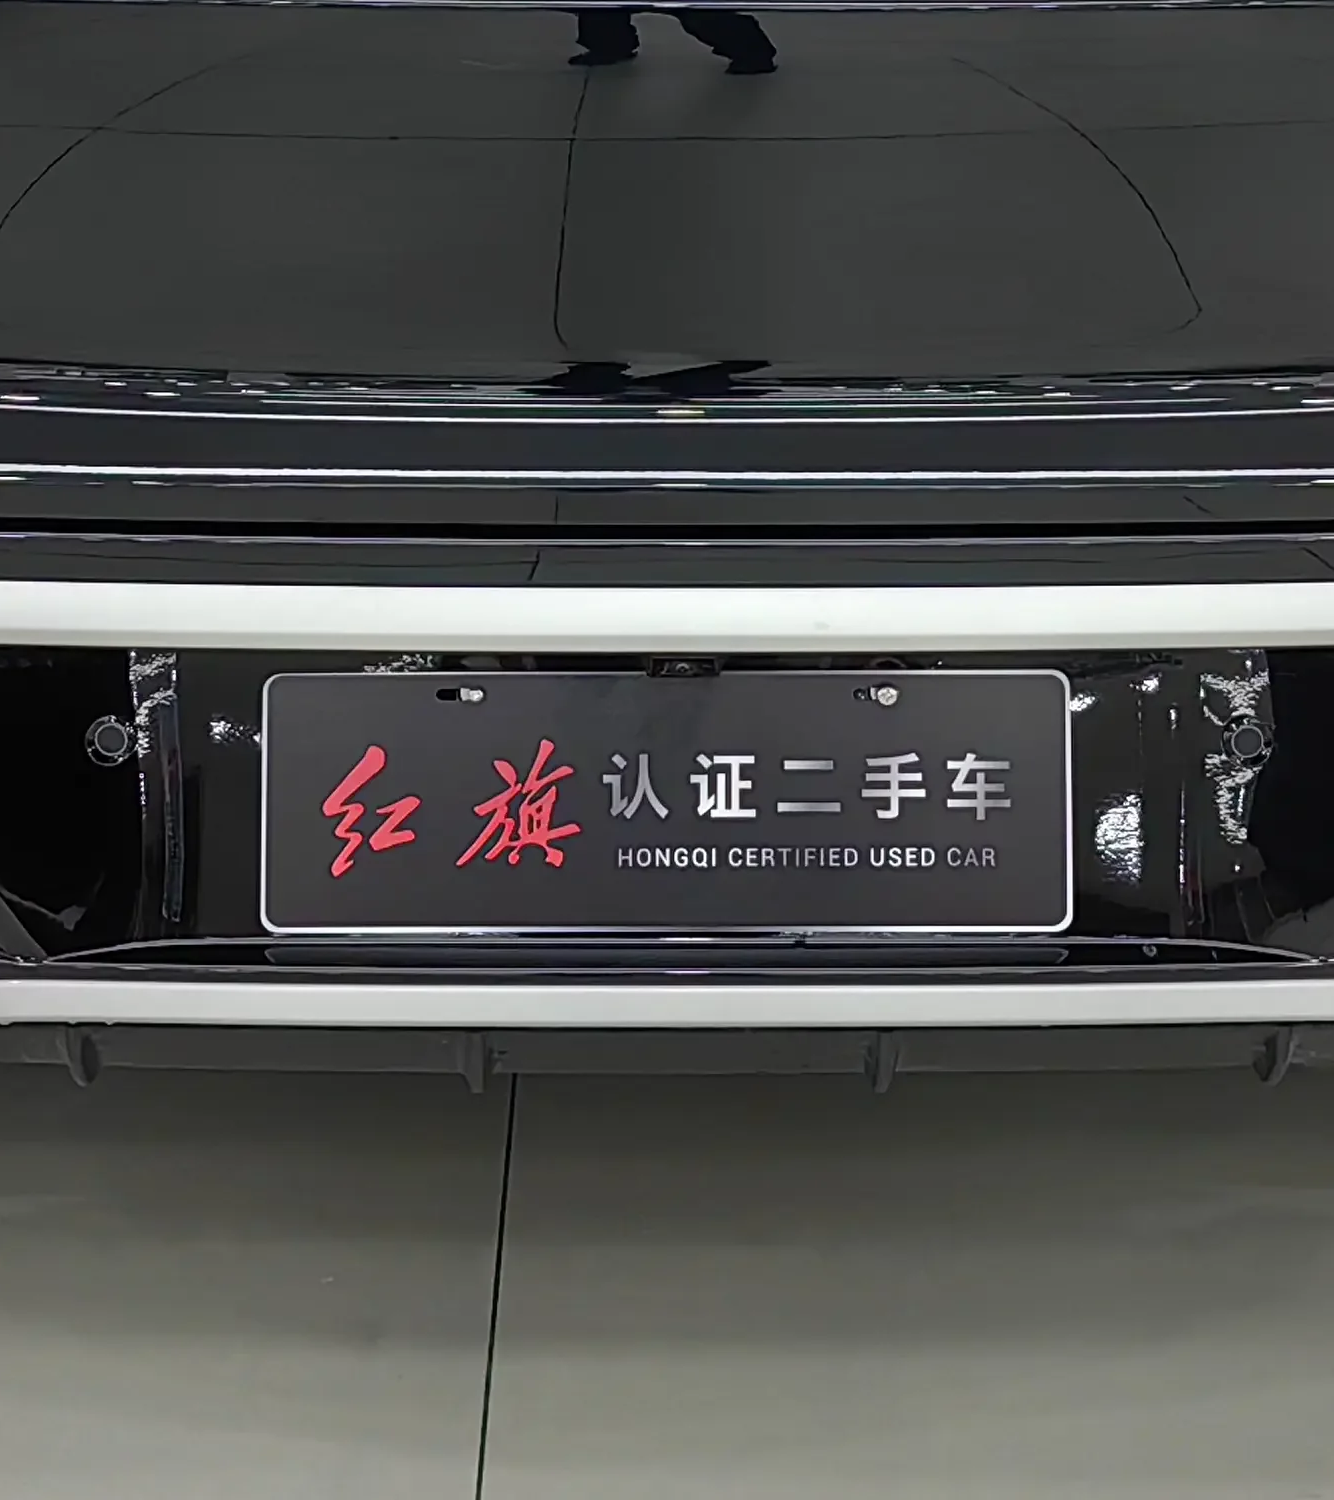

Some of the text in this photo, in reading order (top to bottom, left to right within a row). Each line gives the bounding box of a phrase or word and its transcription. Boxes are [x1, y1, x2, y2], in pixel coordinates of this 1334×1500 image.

[321, 738, 1013, 878] 红旗 认证二手车
[617, 846, 997, 868] HONGQI CERTIFIED USED CAR
